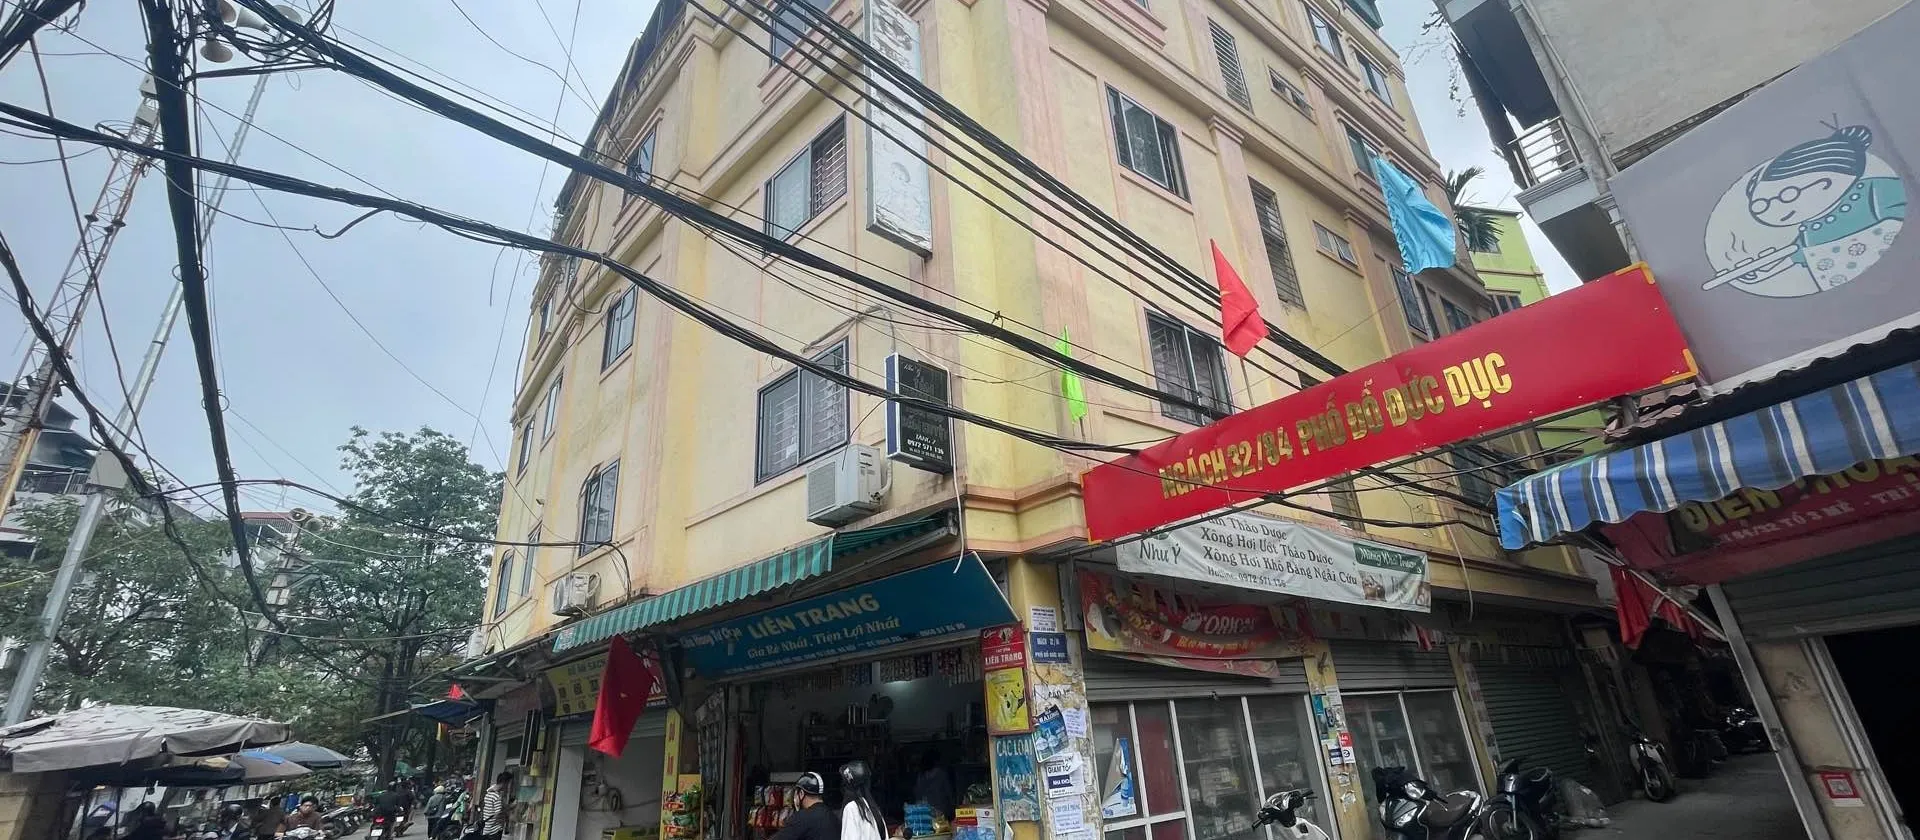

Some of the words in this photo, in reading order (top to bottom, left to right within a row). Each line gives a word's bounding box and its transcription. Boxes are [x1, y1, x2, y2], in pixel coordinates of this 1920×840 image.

[1159, 448, 1228, 500] NGÁCH
[1296, 393, 1346, 456] PHỐ
[1345, 379, 1385, 441] ĐỖ
[1383, 367, 1446, 427] ĐỨC
[1443, 352, 1513, 409] DỤC
[1201, 526, 1233, 548] Xông
[1236, 534, 1256, 550] Hơi
[1280, 543, 1306, 560] Thảo
[1308, 549, 1334, 568] Dược
[1228, 517, 1258, 535] Thảo
[1261, 524, 1288, 543] Dược
[1139, 541, 1169, 563] Như
[1203, 545, 1238, 568] Xông
[1240, 554, 1261, 569] Hơi
[1263, 555, 1285, 573] Khô
[1338, 571, 1359, 586] Cứu
[747, 615, 796, 640] LIÊN
[795, 593, 880, 628] TRANG
[814, 631, 842, 647] Tiện
[865, 615, 902, 634] Nhất
[985, 654, 1000, 666] LIÊN
[1000, 651, 1023, 664] TRANG
